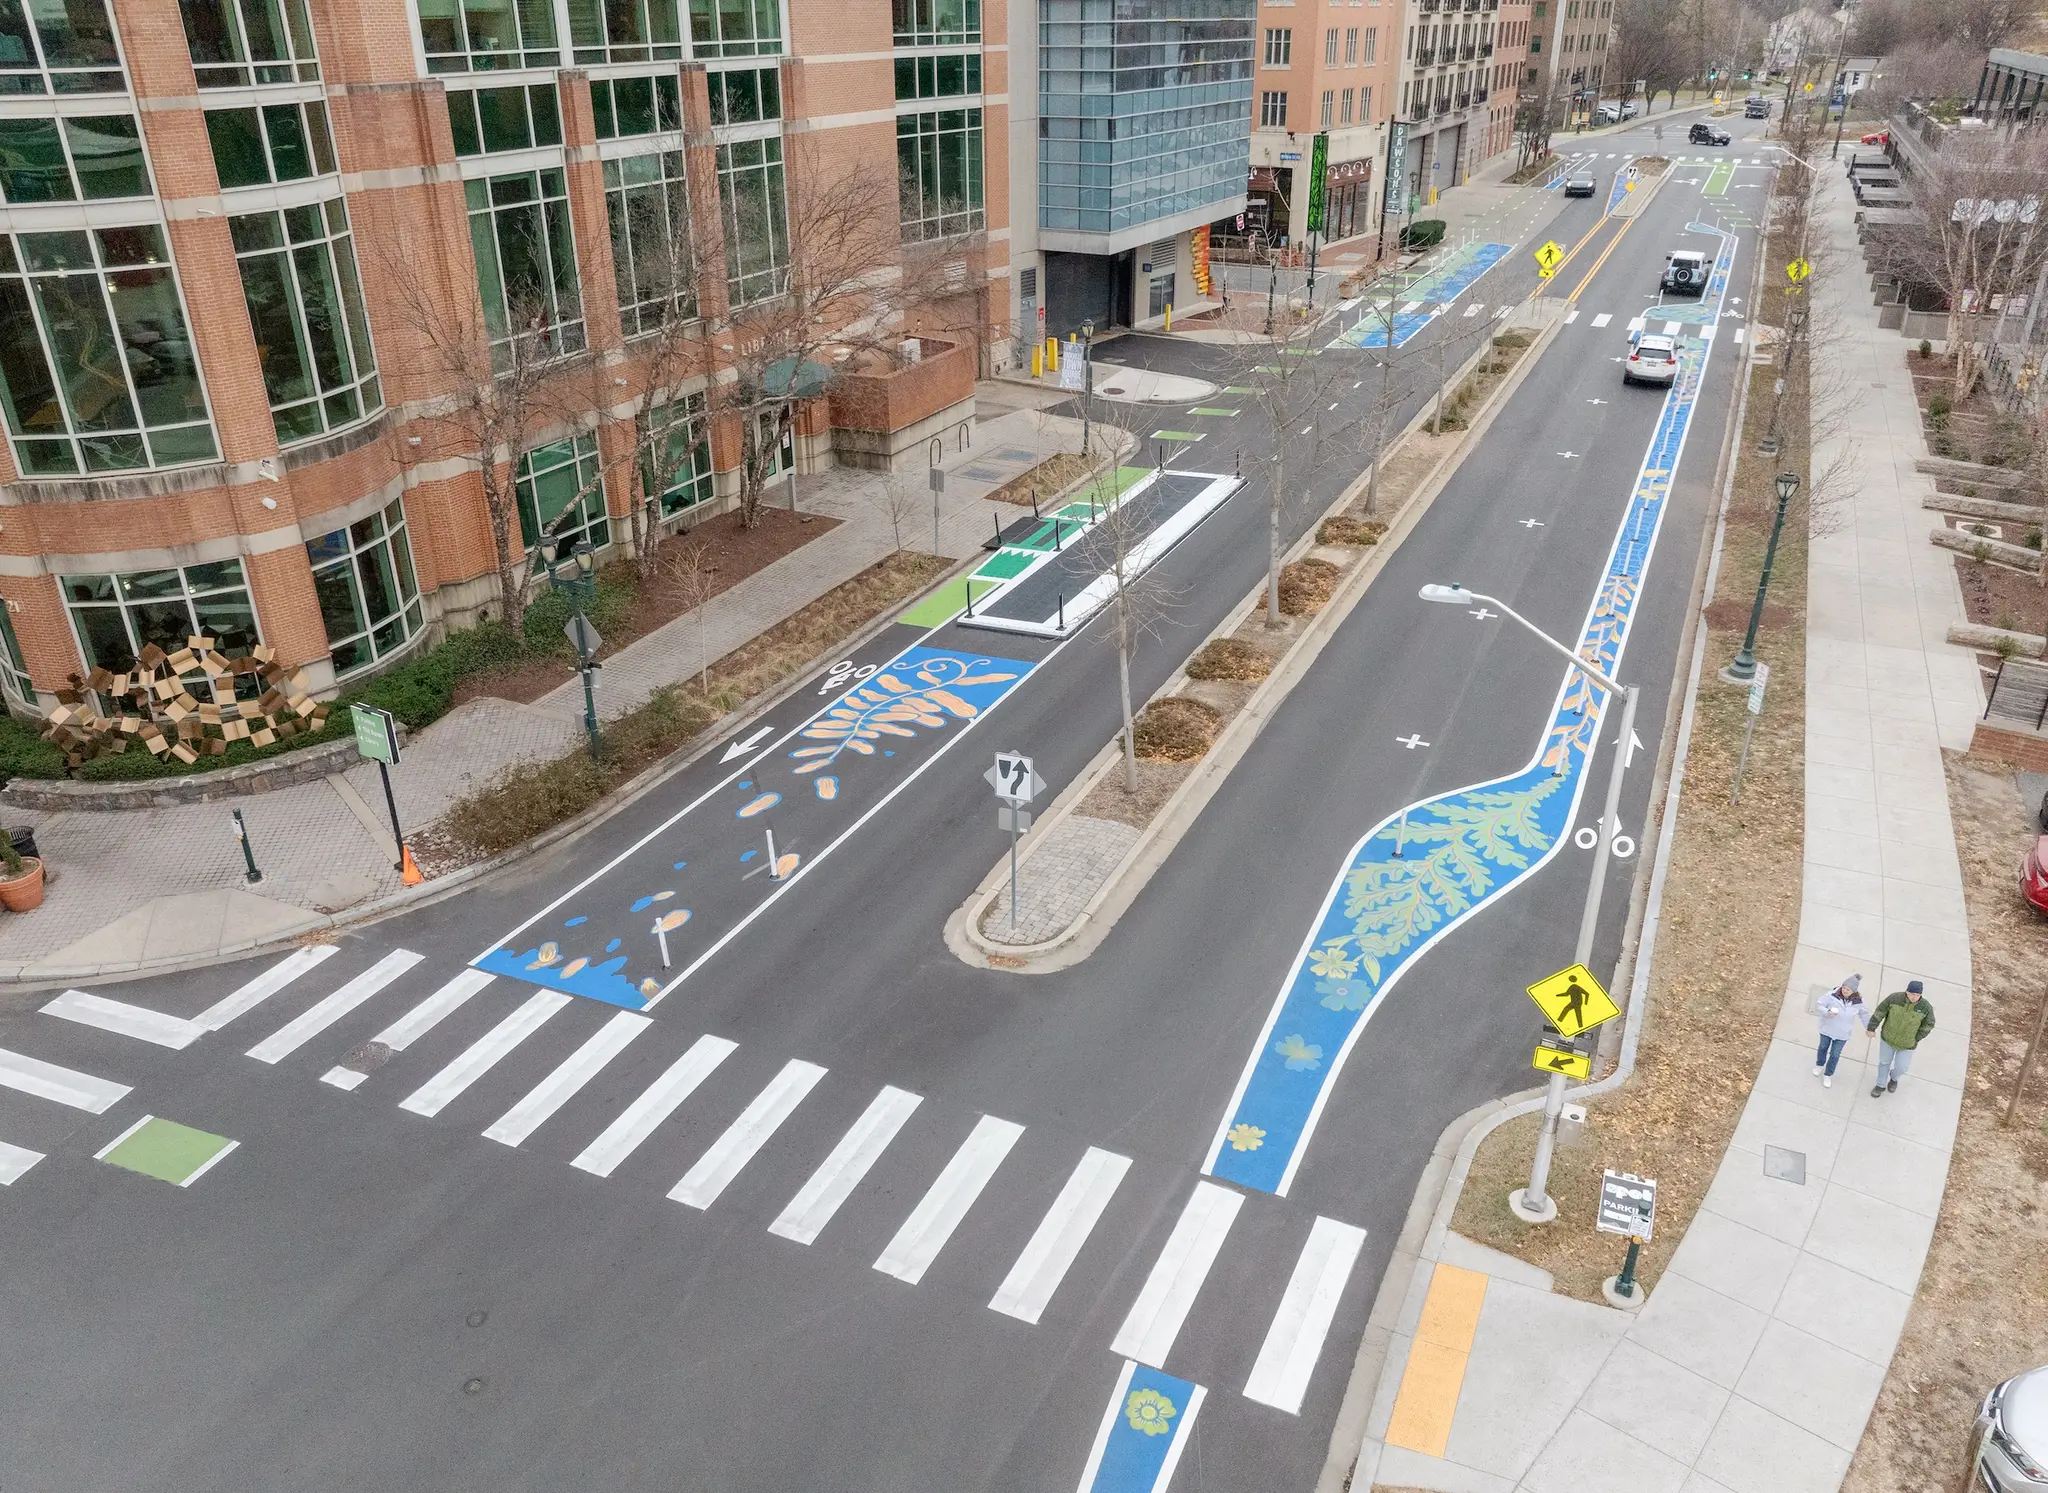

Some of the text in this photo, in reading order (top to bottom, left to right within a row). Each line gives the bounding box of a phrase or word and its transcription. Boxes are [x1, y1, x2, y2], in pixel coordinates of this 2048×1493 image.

[1063, 359, 1082, 371] TOWN
[7, 600, 20, 613] 21
[1605, 1182, 1653, 1202] spot
[1603, 1200, 1651, 1217] PARKI
